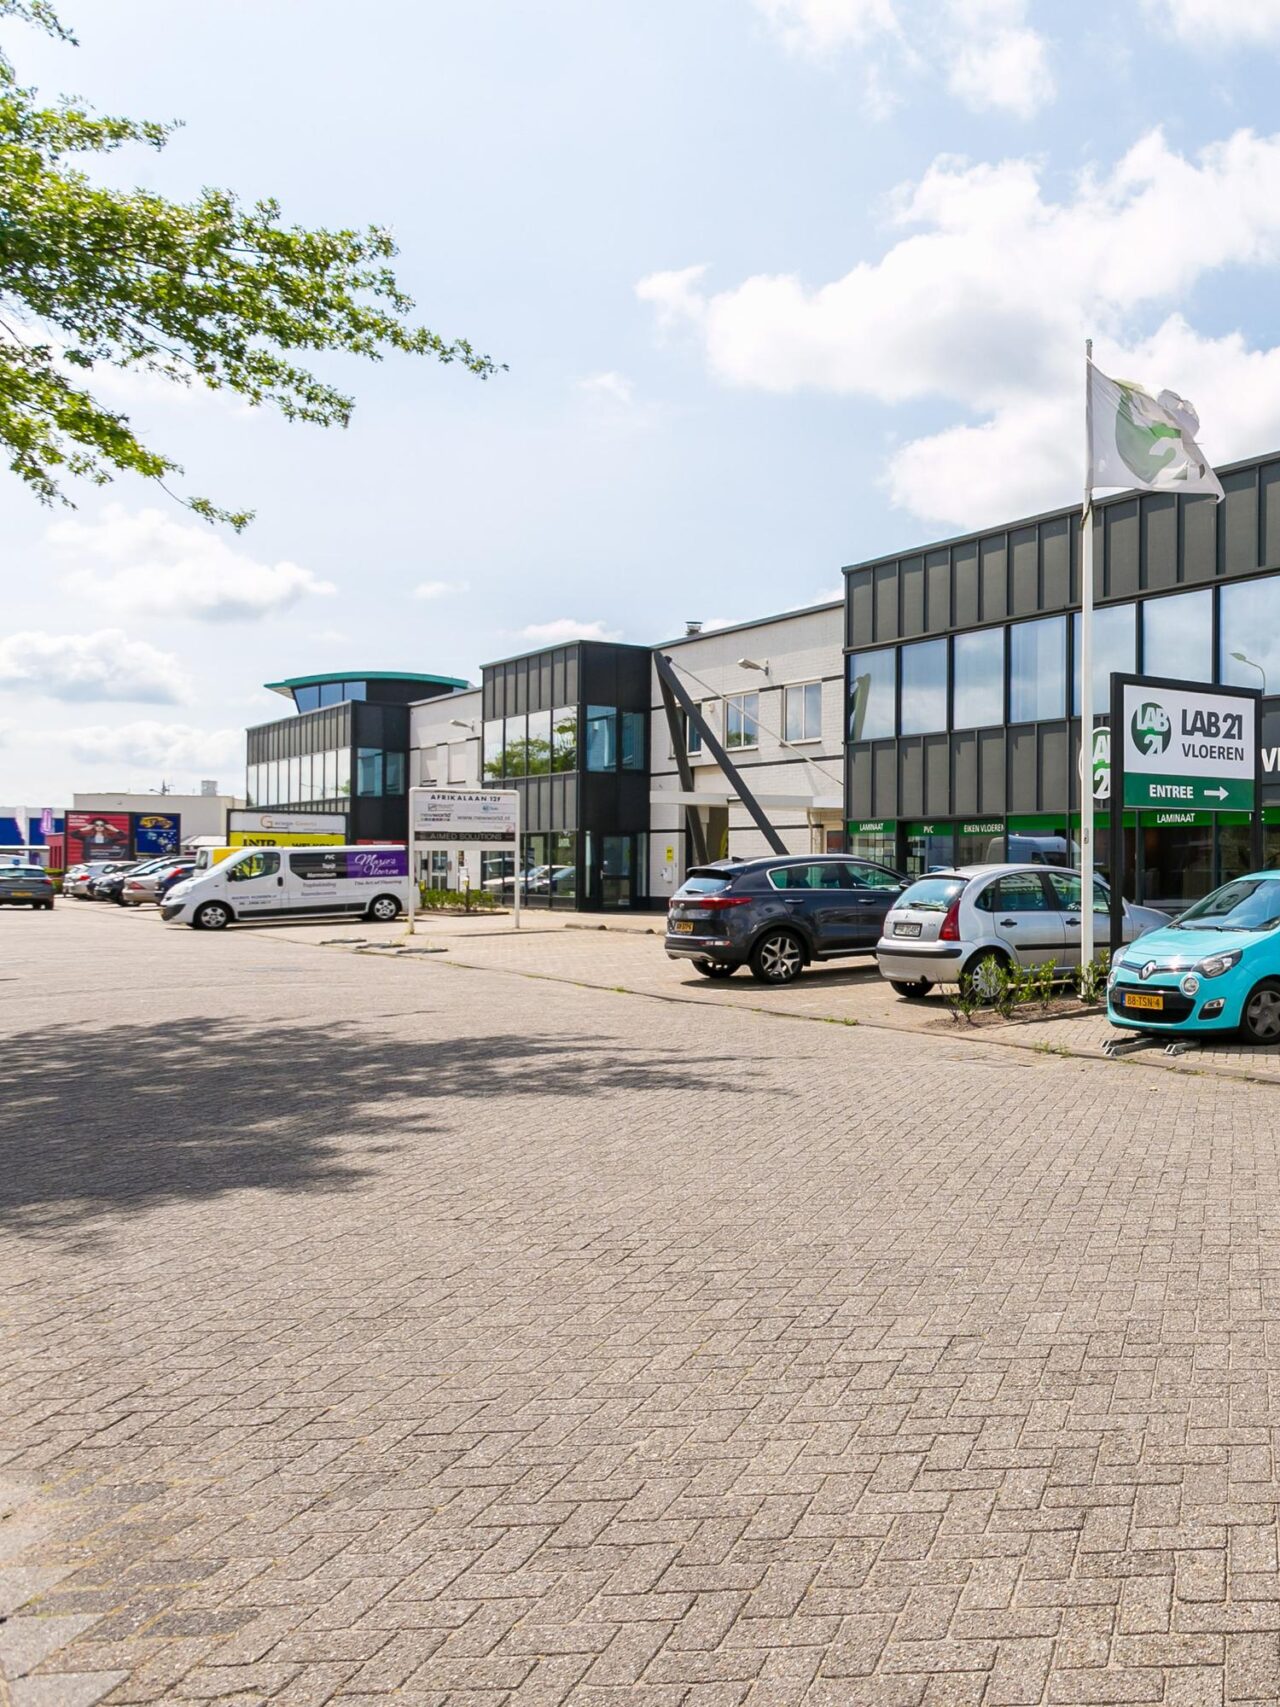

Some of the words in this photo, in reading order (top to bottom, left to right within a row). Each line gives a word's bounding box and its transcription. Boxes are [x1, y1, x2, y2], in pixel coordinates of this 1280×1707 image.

[1181, 743, 1244, 761] VLOEREN
[1149, 784, 1194, 799] ENTREE
[1156, 812, 1196, 824] LAMINAAT
[859, 822, 884, 831] LAMINAAT
[923, 825, 934, 834] PVC
[963, 824, 980, 833] EIKEN
